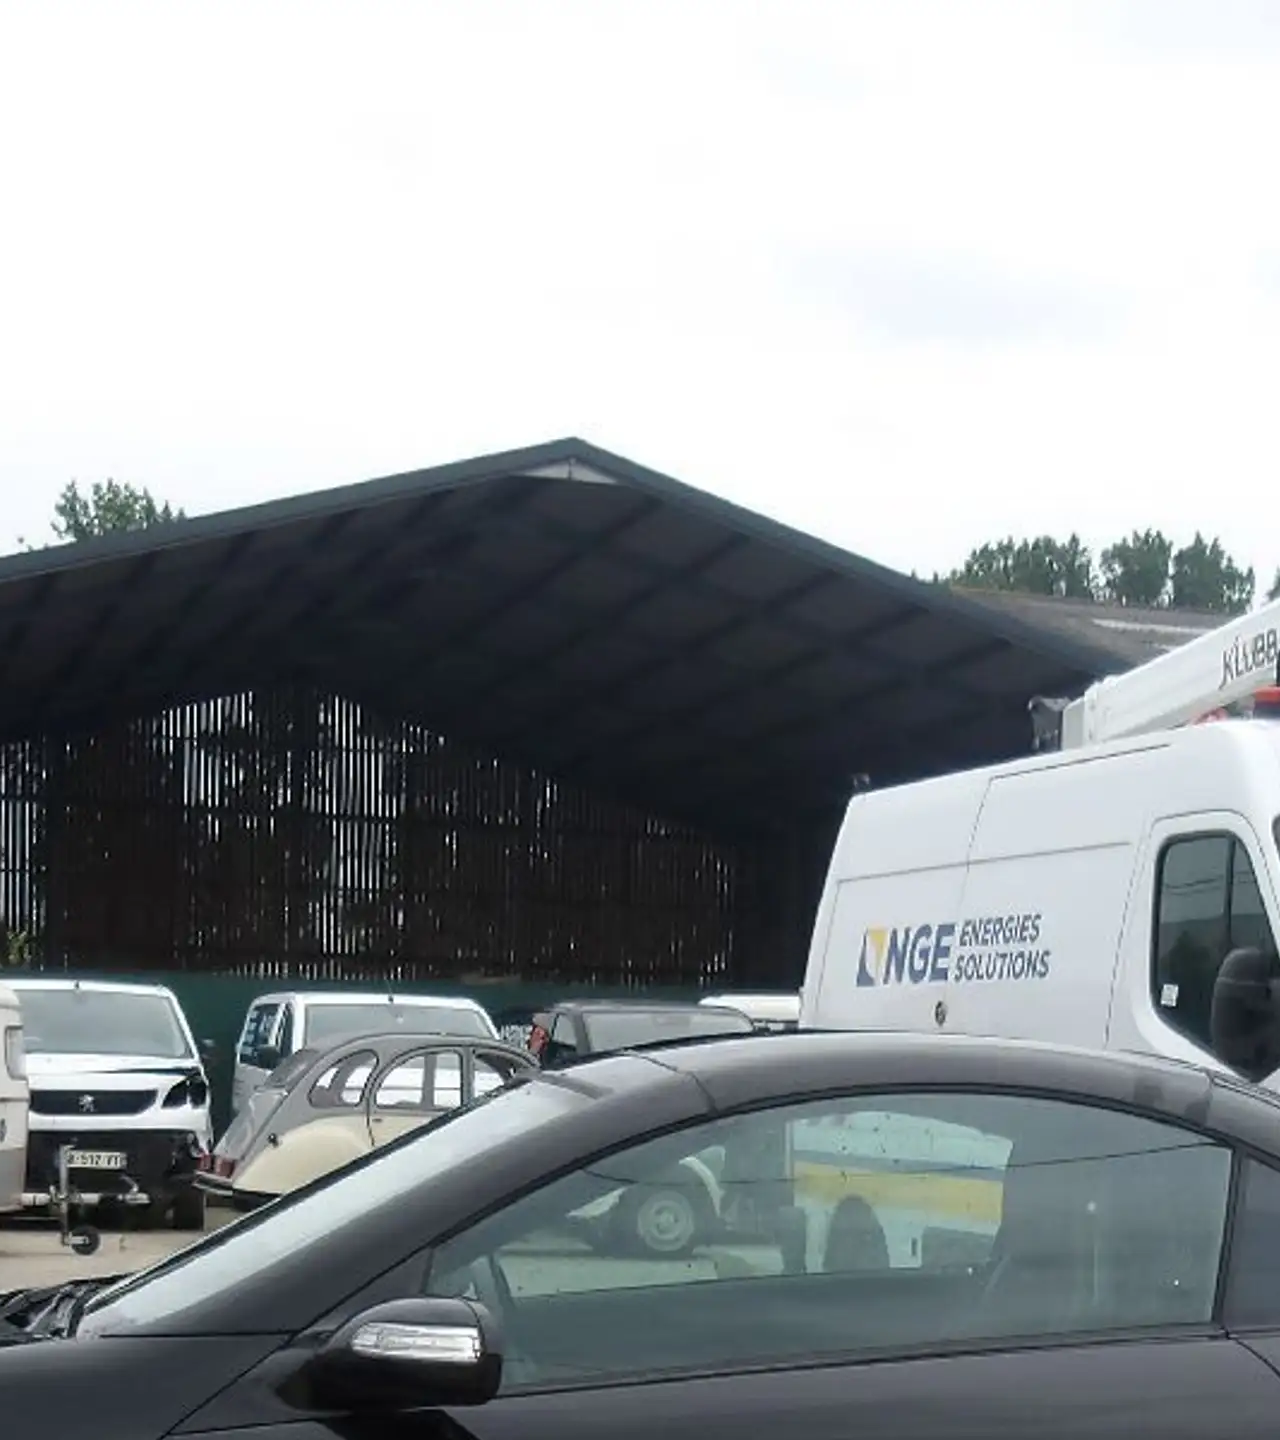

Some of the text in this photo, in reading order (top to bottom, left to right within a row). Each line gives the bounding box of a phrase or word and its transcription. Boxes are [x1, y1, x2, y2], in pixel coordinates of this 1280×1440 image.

[959, 914, 1042, 947] ENERGIES
[883, 923, 956, 984] NGE
[954, 950, 1051, 982] SOLUTIONS
